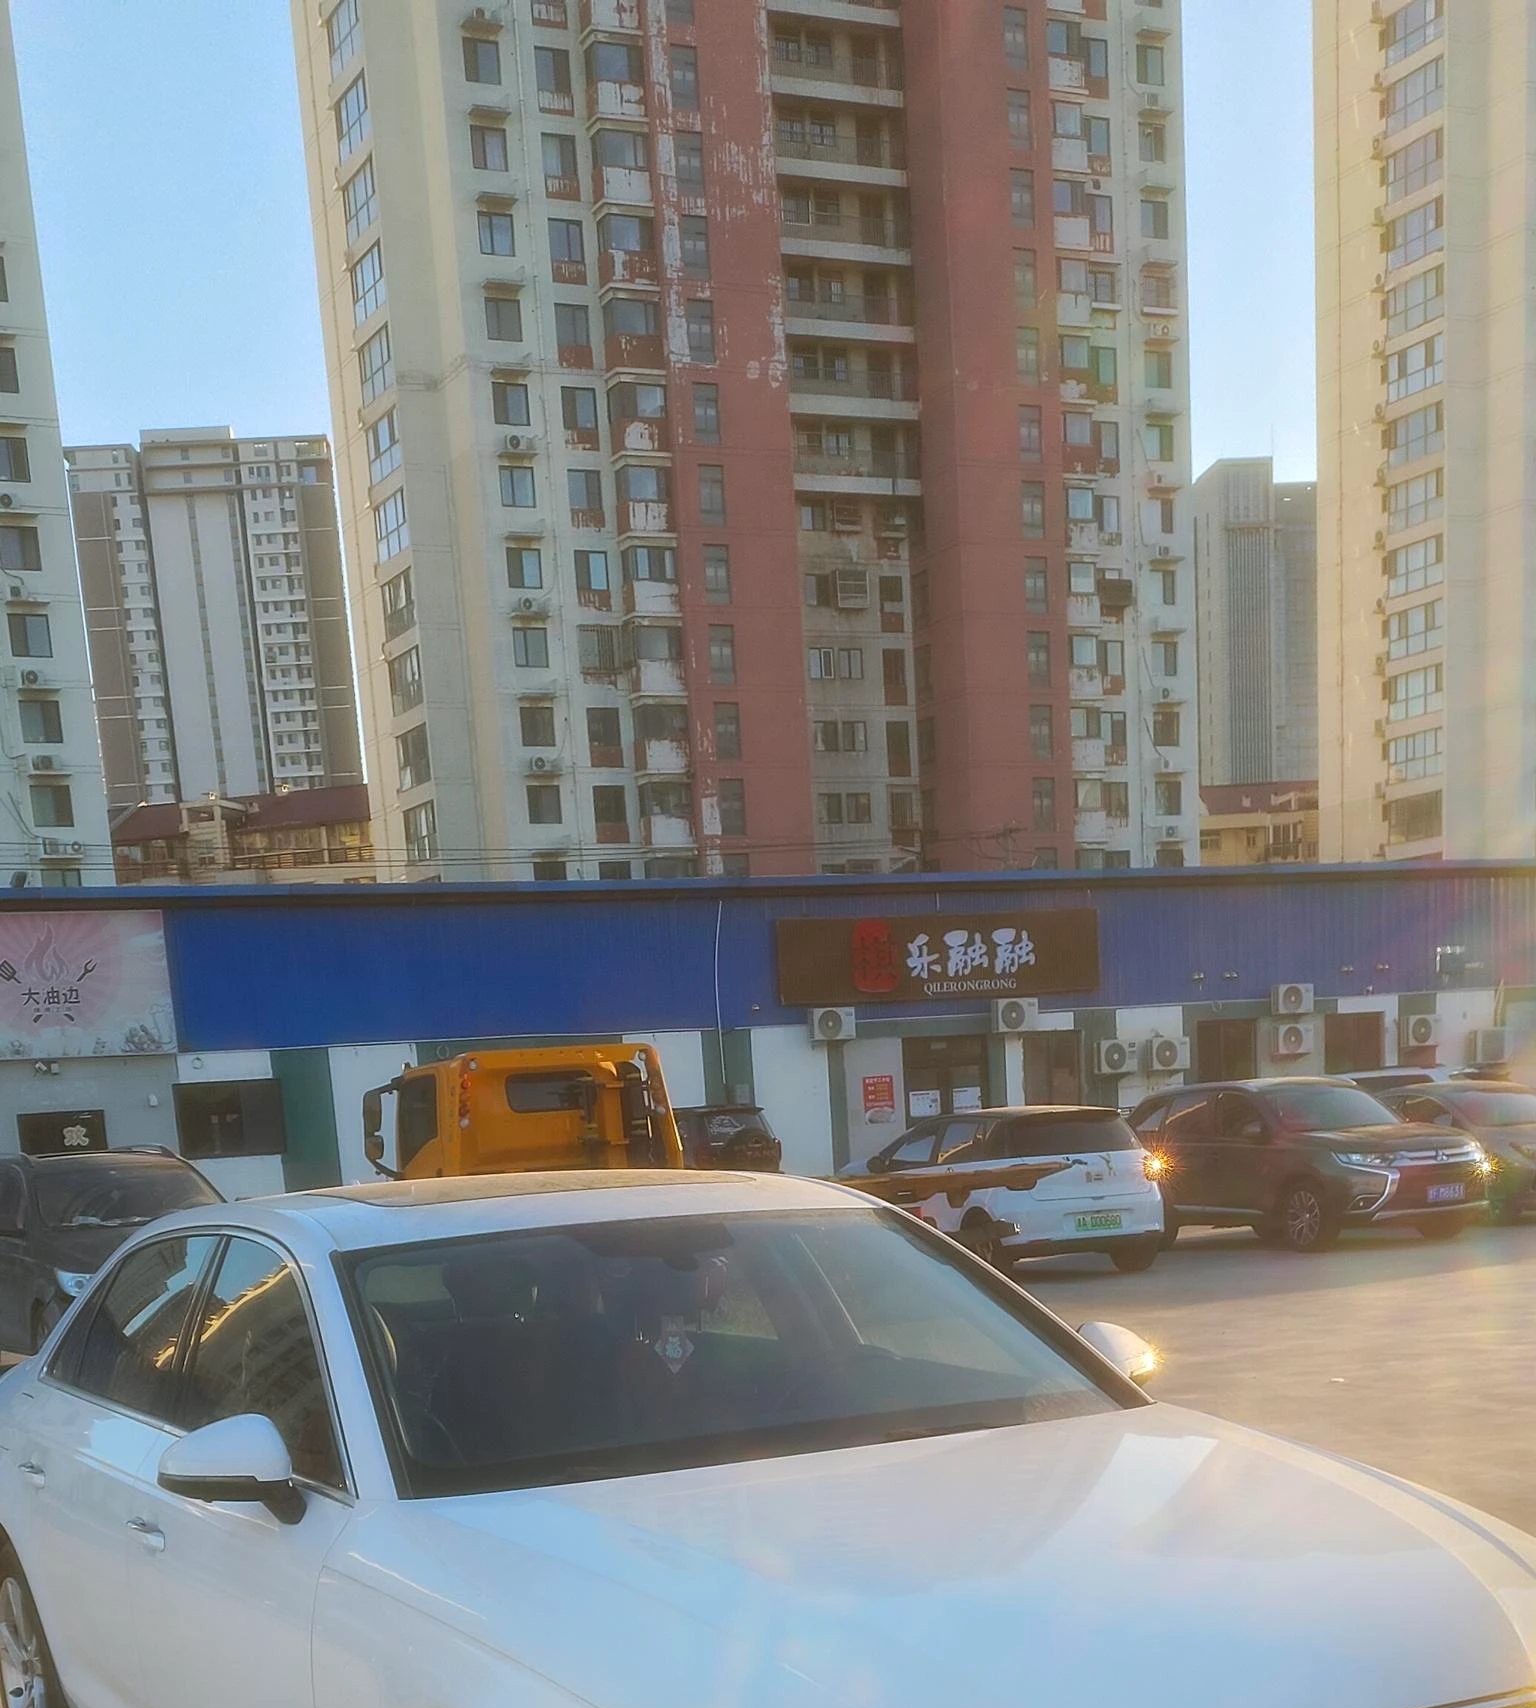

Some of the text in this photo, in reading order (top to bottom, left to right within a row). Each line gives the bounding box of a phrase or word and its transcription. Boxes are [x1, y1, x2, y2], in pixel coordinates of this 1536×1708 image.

[21, 986, 80, 1006] 大油边
[924, 978, 1017, 996] QILERONGRONG
